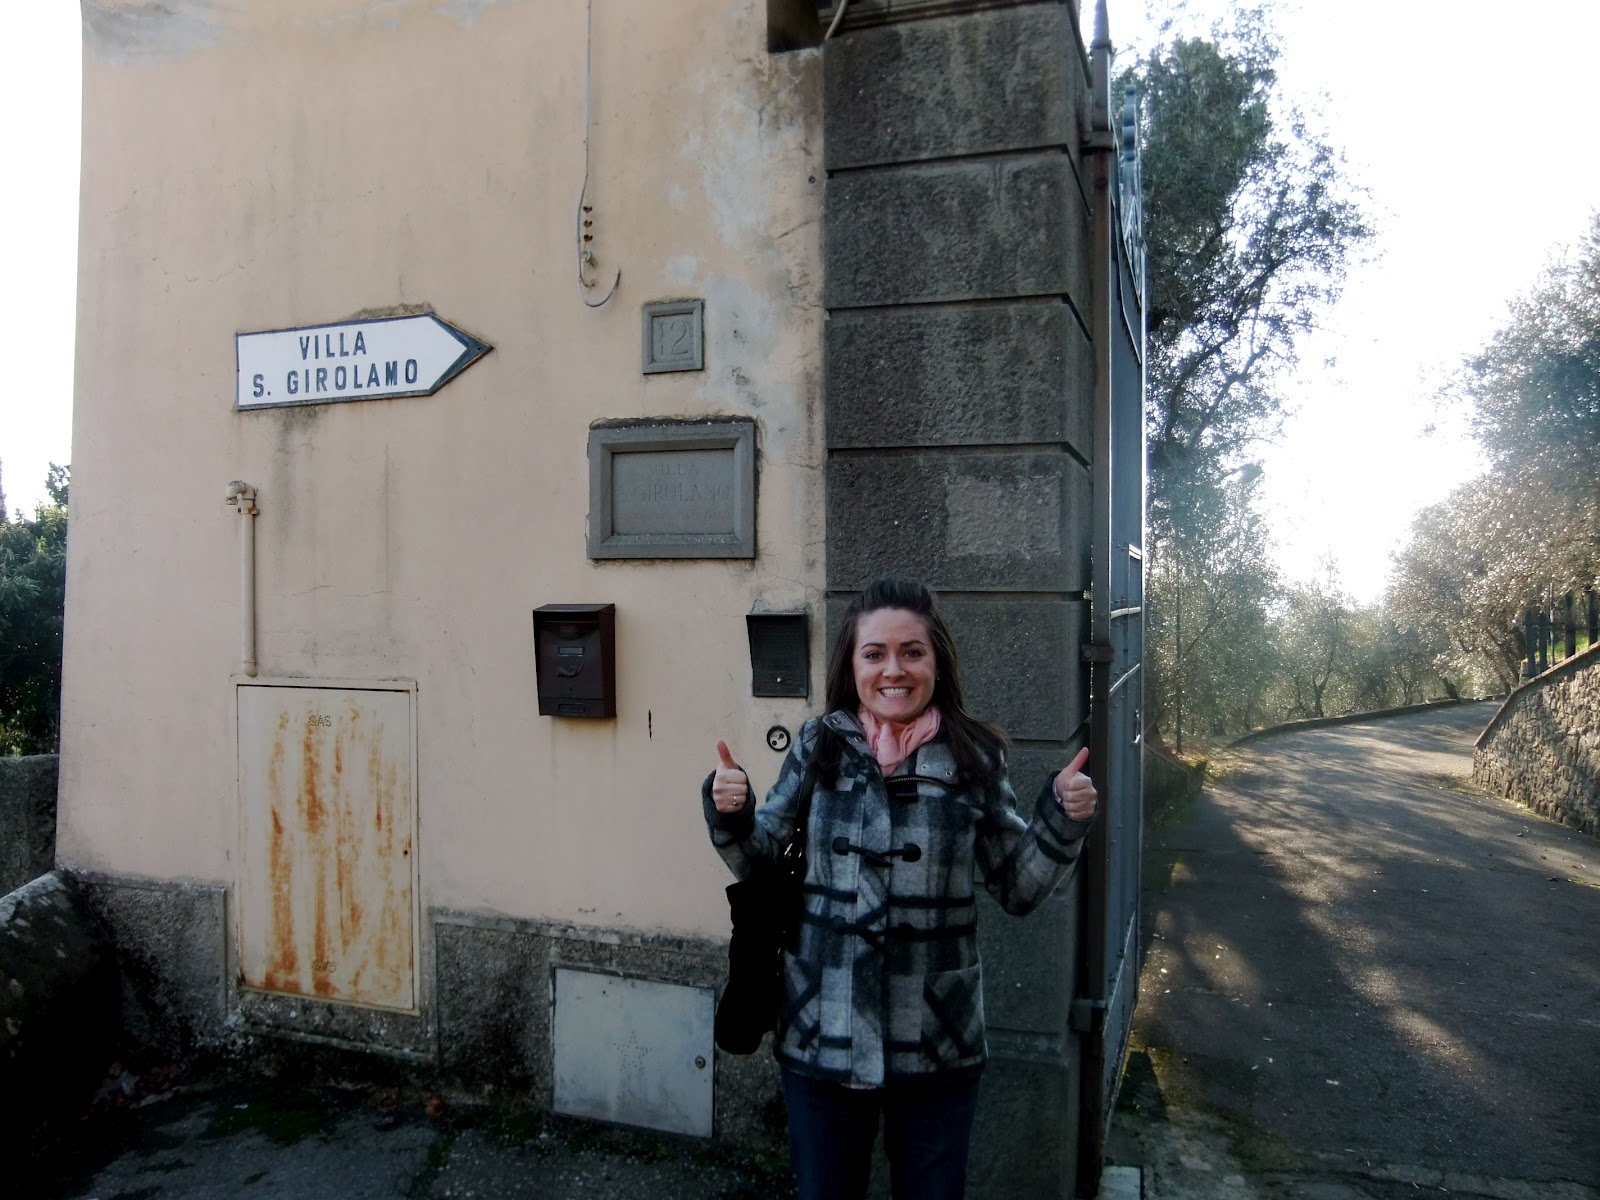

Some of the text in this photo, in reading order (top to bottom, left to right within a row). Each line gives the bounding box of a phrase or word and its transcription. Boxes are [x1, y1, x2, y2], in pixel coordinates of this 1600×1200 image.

[299, 331, 367, 360] VILLA
[657, 319, 689, 356] 12
[253, 359, 418, 397] S. GIROLAMO
[648, 463, 700, 476] VILLA
[308, 714, 332, 728] GAS
